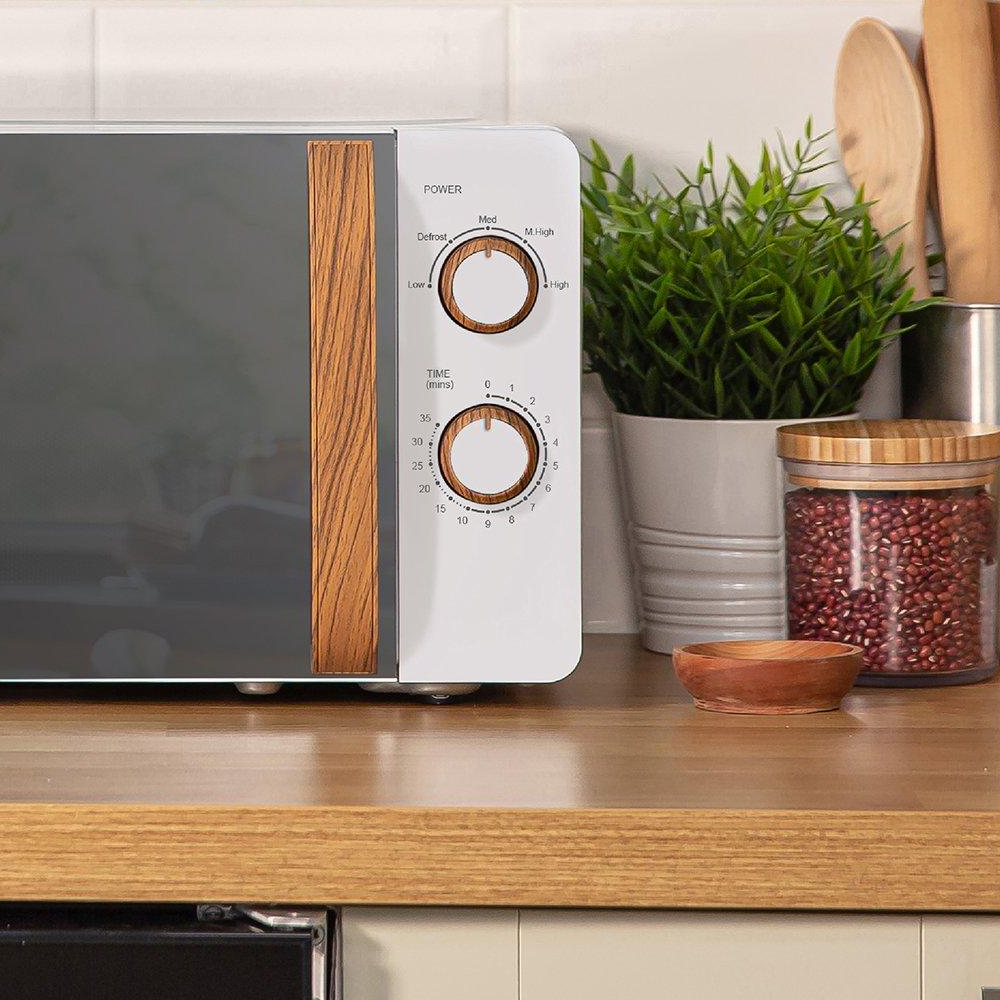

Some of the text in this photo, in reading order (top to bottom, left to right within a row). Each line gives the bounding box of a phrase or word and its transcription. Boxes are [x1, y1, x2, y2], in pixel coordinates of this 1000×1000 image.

[424, 185, 462, 194] POWER
[479, 216, 497, 224] Med
[524, 228, 554, 236] M.High
[417, 233, 447, 241] Defrost
[408, 281, 425, 289] Low
[550, 281, 569, 290] High
[426, 369, 450, 378] TIME
[426, 380, 454, 390] (mins)
[485, 380, 490, 388] 0
[530, 397, 536, 405] 2
[420, 414, 431, 422] 35
[411, 438, 423, 446] 30
[553, 438, 558, 446] 4
[412, 462, 423, 470] 25
[553, 462, 558, 470] 5
[419, 485, 431, 493] 20
[545, 484, 551, 492] 6
[458, 517, 468, 525] 10
[485, 520, 491, 528] 9
[509, 516, 515, 524] 8
